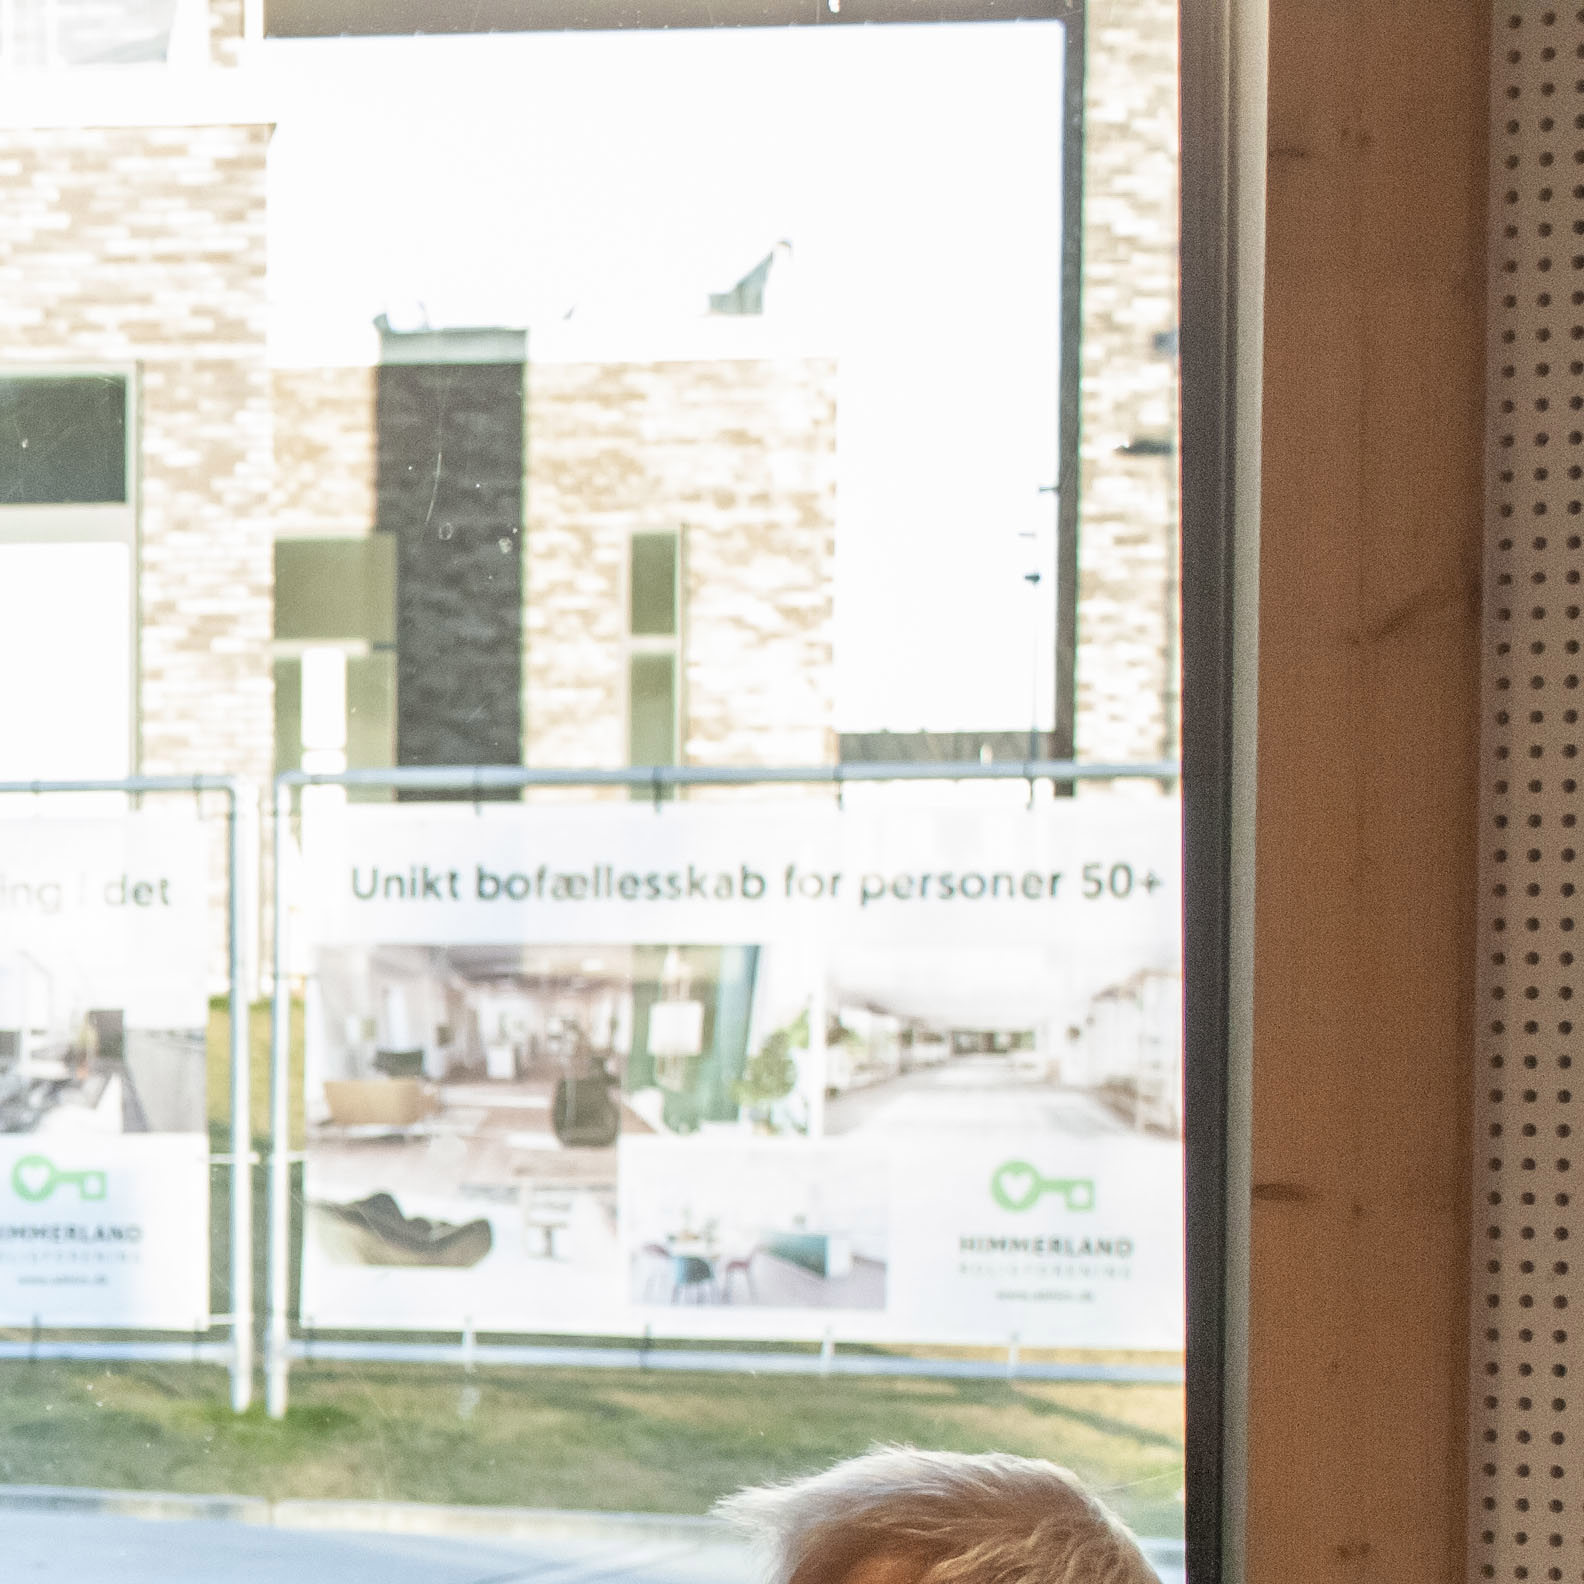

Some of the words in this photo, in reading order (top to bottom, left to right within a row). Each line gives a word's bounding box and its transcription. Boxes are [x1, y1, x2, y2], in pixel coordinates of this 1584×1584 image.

[103, 873, 171, 907] det
[351, 864, 460, 901] Unikt
[475, 863, 766, 901] bofællesskab
[784, 861, 841, 899] for
[860, 870, 1063, 908] personer
[1080, 860, 1162, 901] 50+
